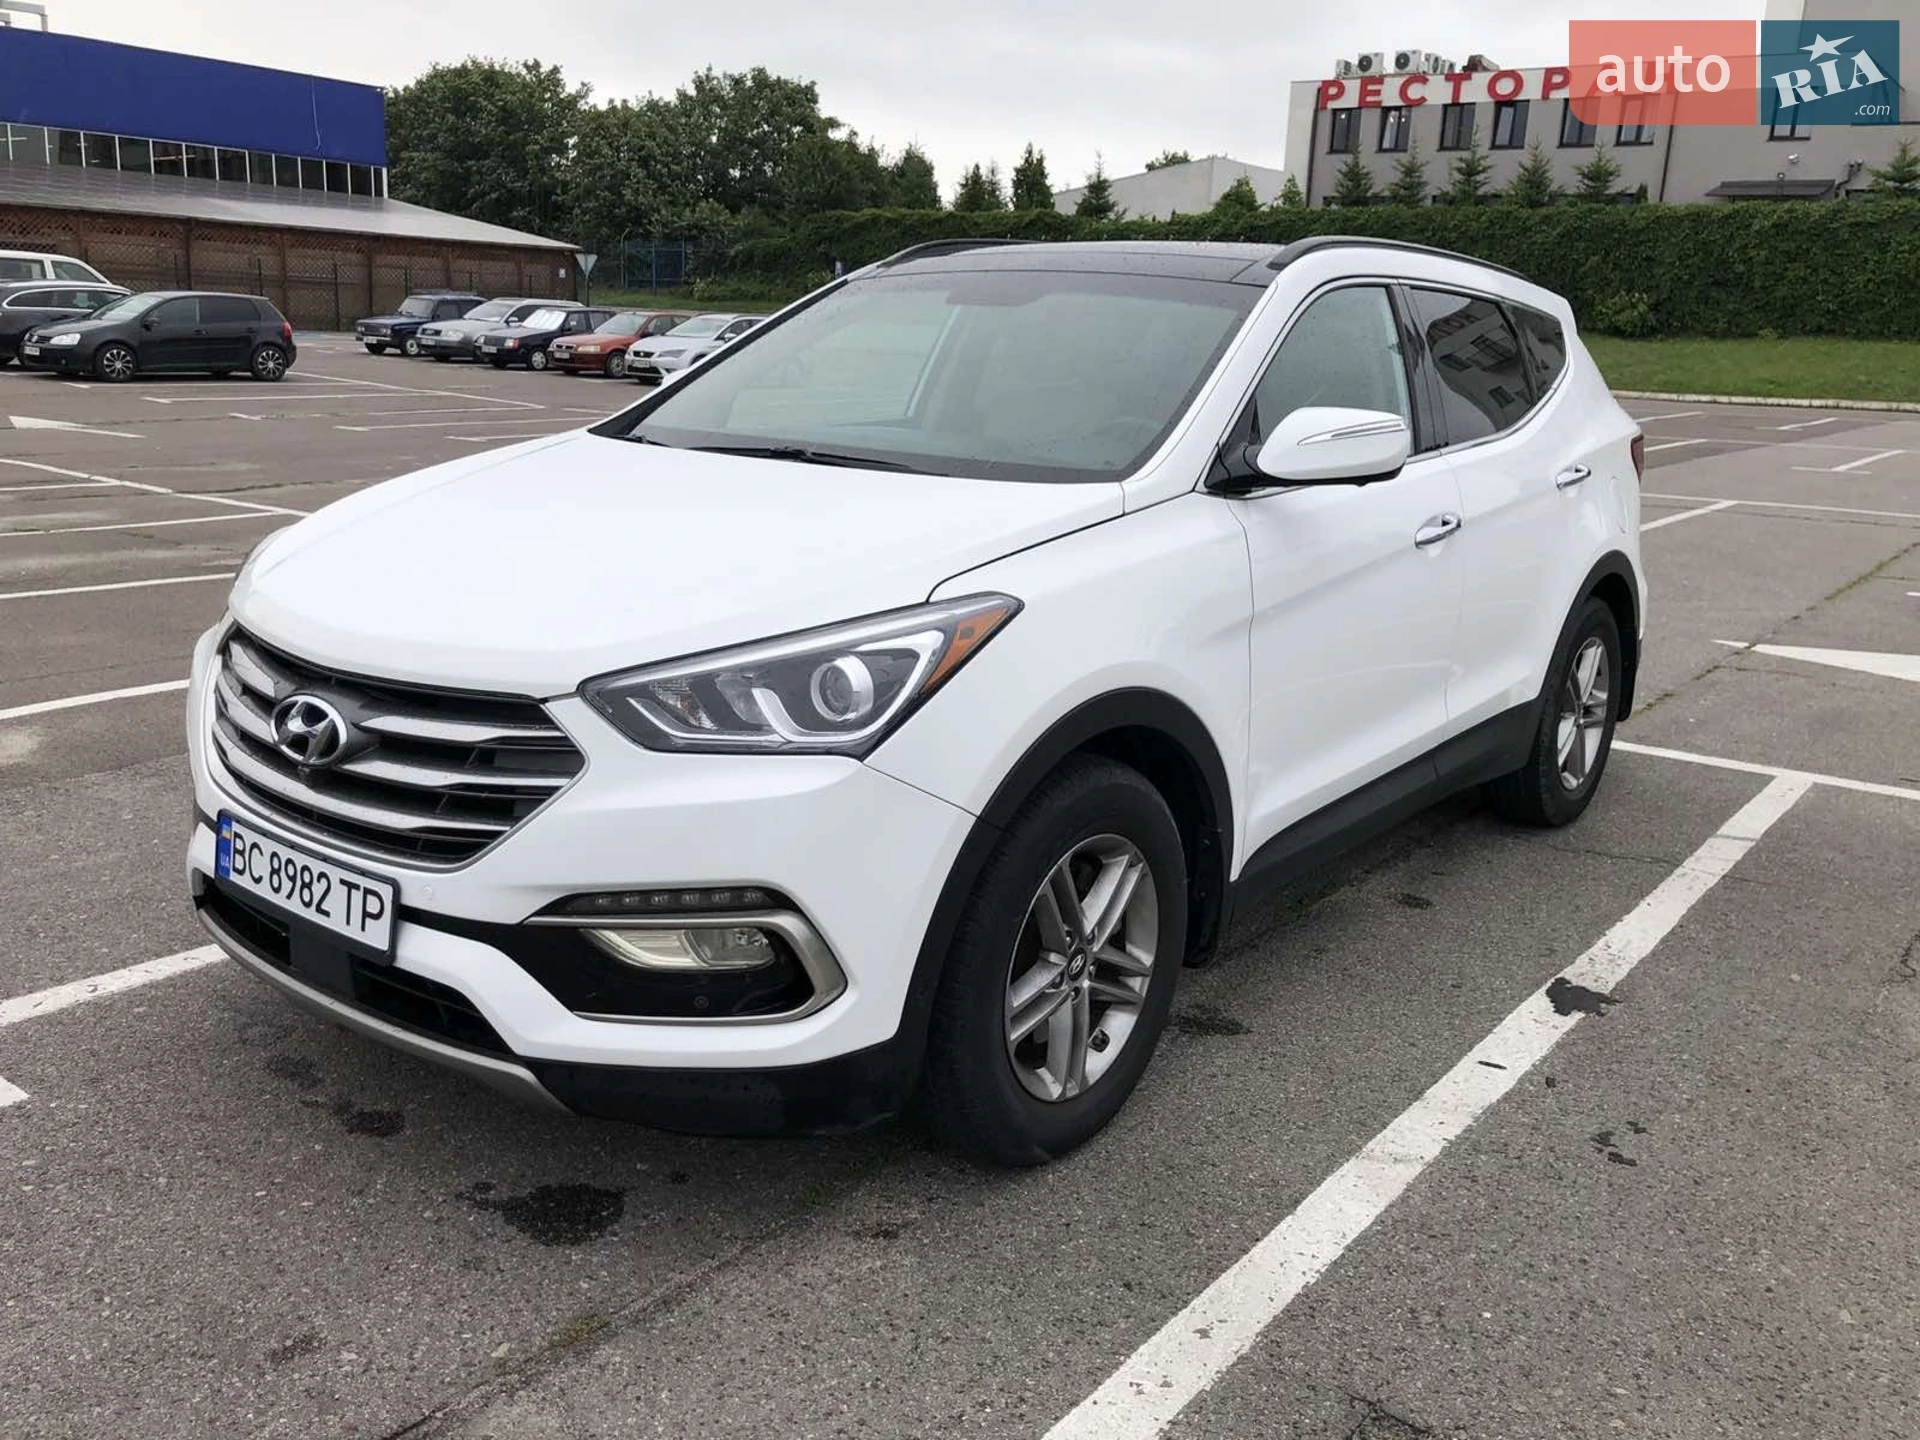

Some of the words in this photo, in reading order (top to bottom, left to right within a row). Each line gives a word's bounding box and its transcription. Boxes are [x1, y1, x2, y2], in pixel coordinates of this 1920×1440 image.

[232, 830, 264, 885] BC
[269, 851, 332, 919] 8982
[339, 877, 385, 932] TP
